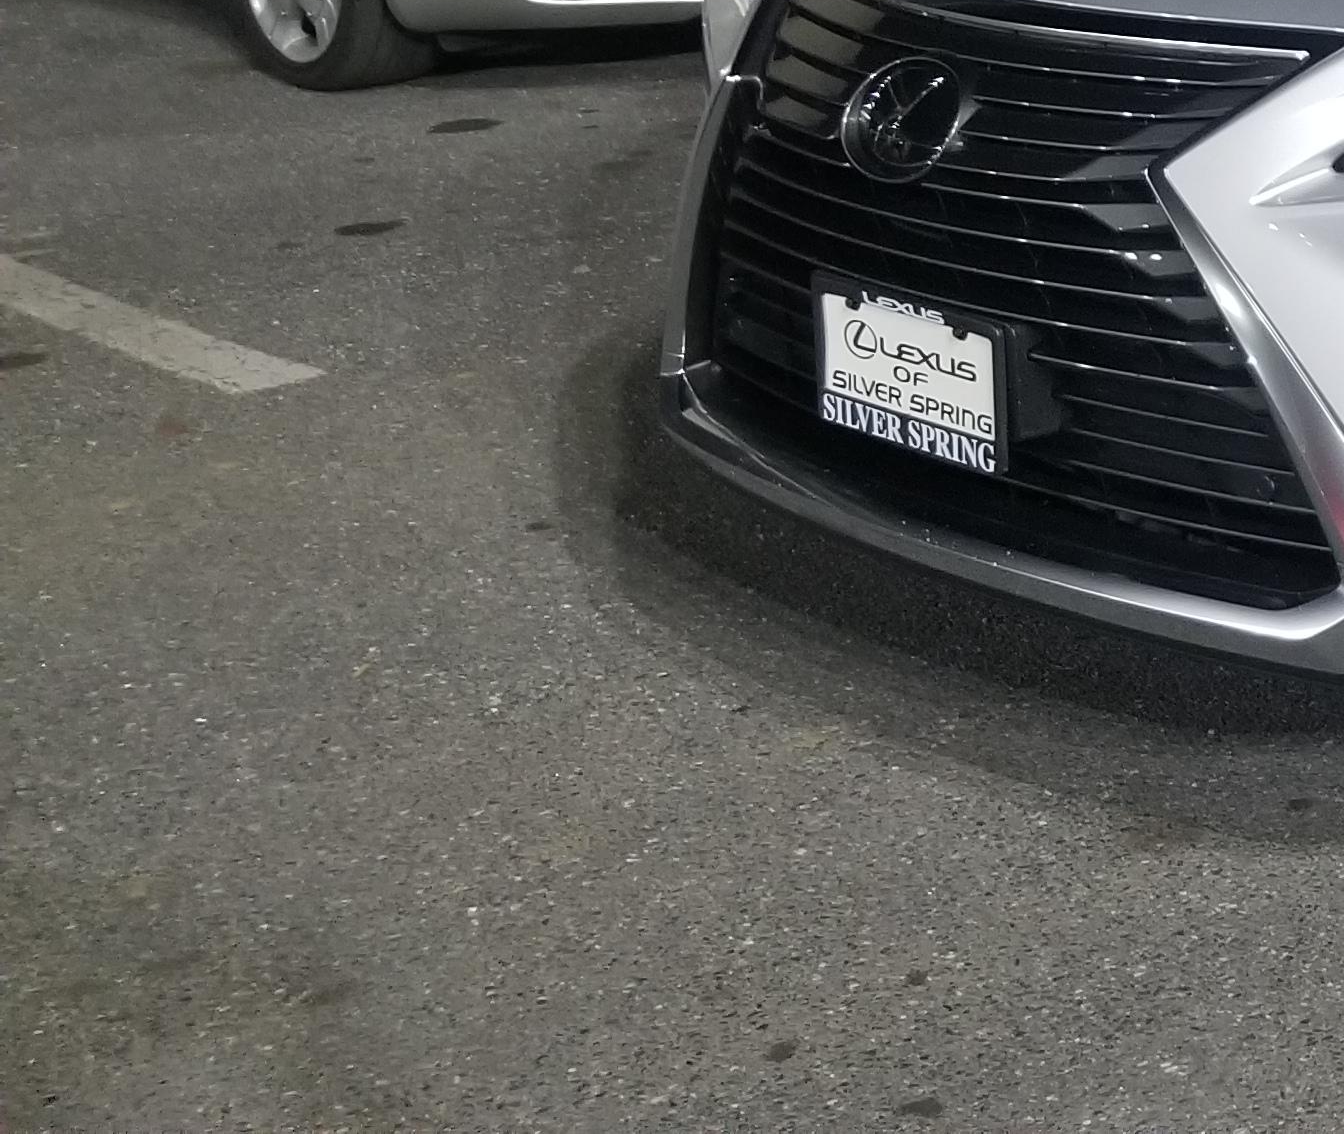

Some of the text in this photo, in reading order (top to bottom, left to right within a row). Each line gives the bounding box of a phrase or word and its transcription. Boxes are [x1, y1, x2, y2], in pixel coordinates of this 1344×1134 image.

[861, 291, 945, 325] LEXUS
[880, 337, 977, 382] LEXUS
[893, 366, 929, 386] OF
[832, 370, 993, 435] SILVER SPRING
[823, 392, 996, 472] SILVER SPRING
